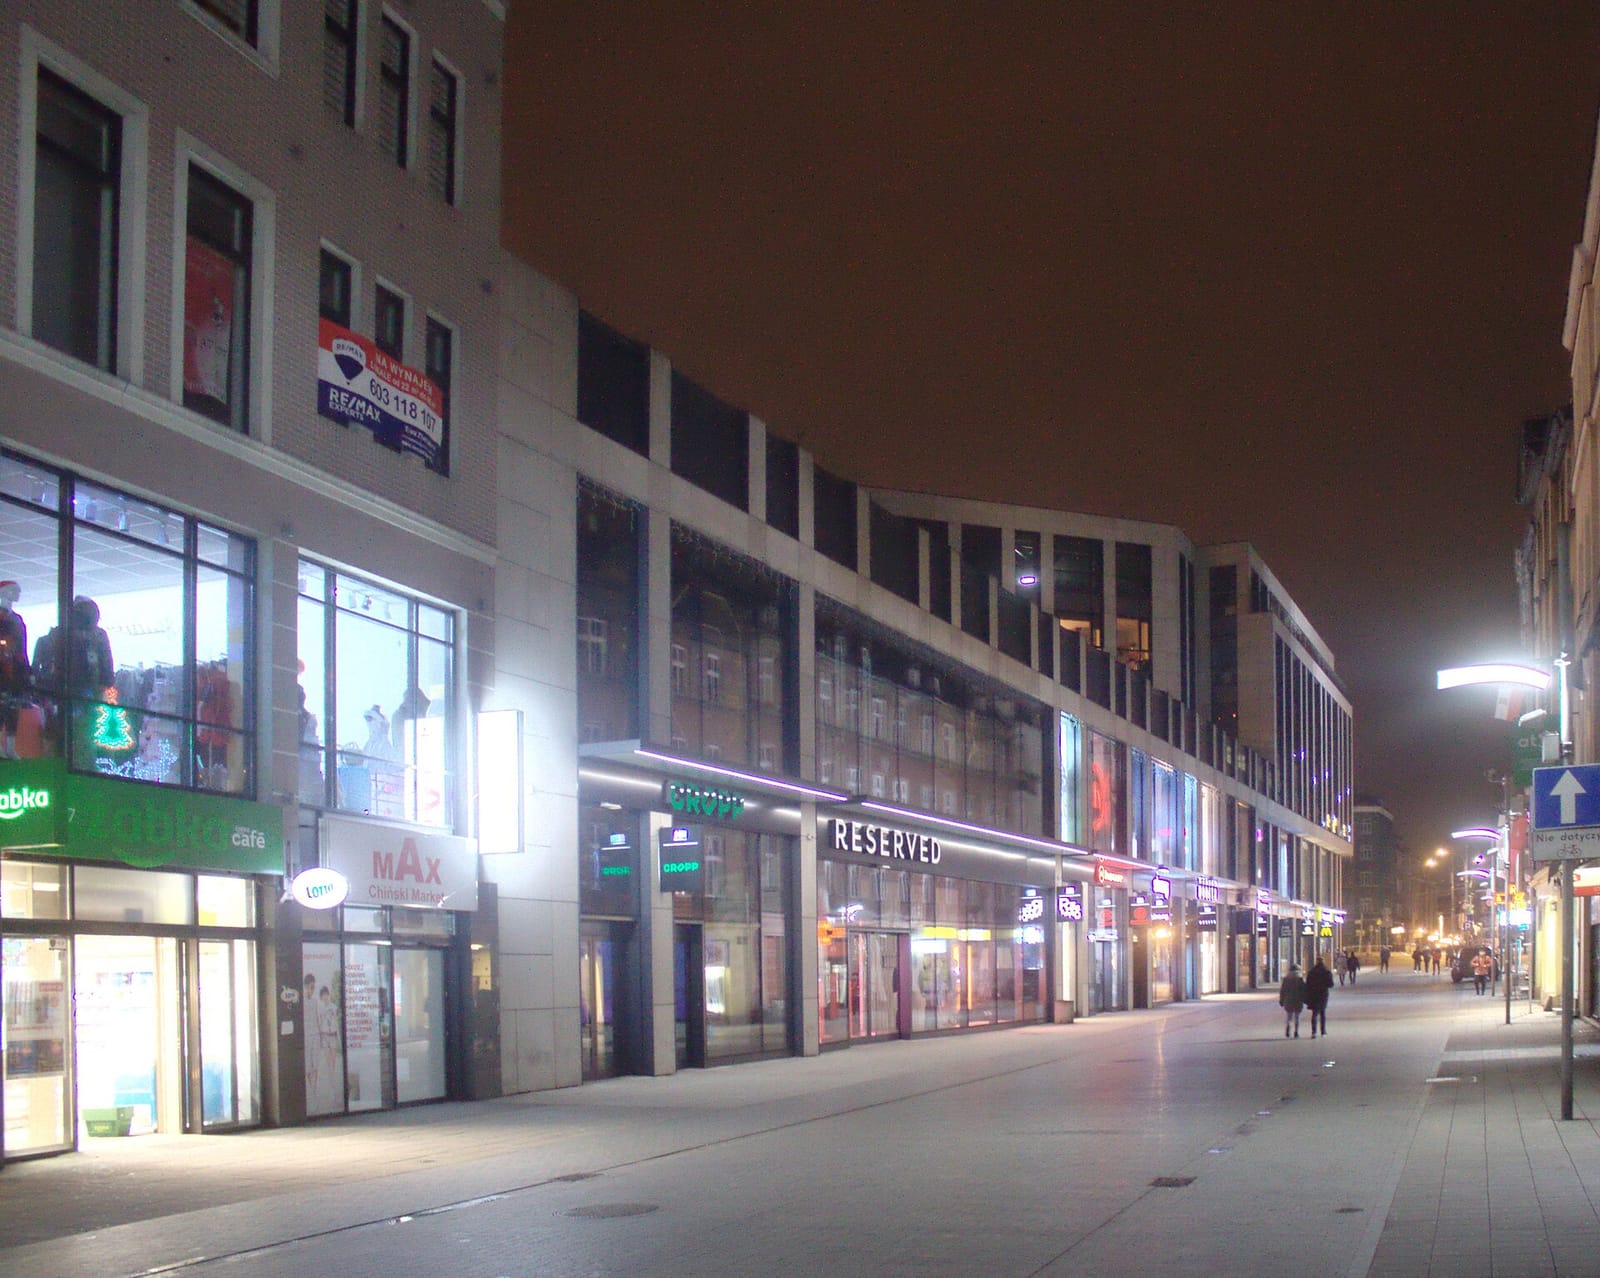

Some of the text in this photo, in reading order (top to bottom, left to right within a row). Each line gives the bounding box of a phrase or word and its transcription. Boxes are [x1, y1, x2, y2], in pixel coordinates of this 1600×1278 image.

[329, 388, 381, 424] RE/MAX
[370, 378, 389, 405] 603
[394, 395, 417, 419] 118
[421, 409, 436, 433] 107
[0, 787, 49, 810] abka
[670, 781, 744, 819] CROPP
[834, 818, 942, 865] RESERVED
[1536, 834, 1555, 842] Nie
[663, 861, 699, 873] CROPP
[368, 884, 408, 900] Chiński
